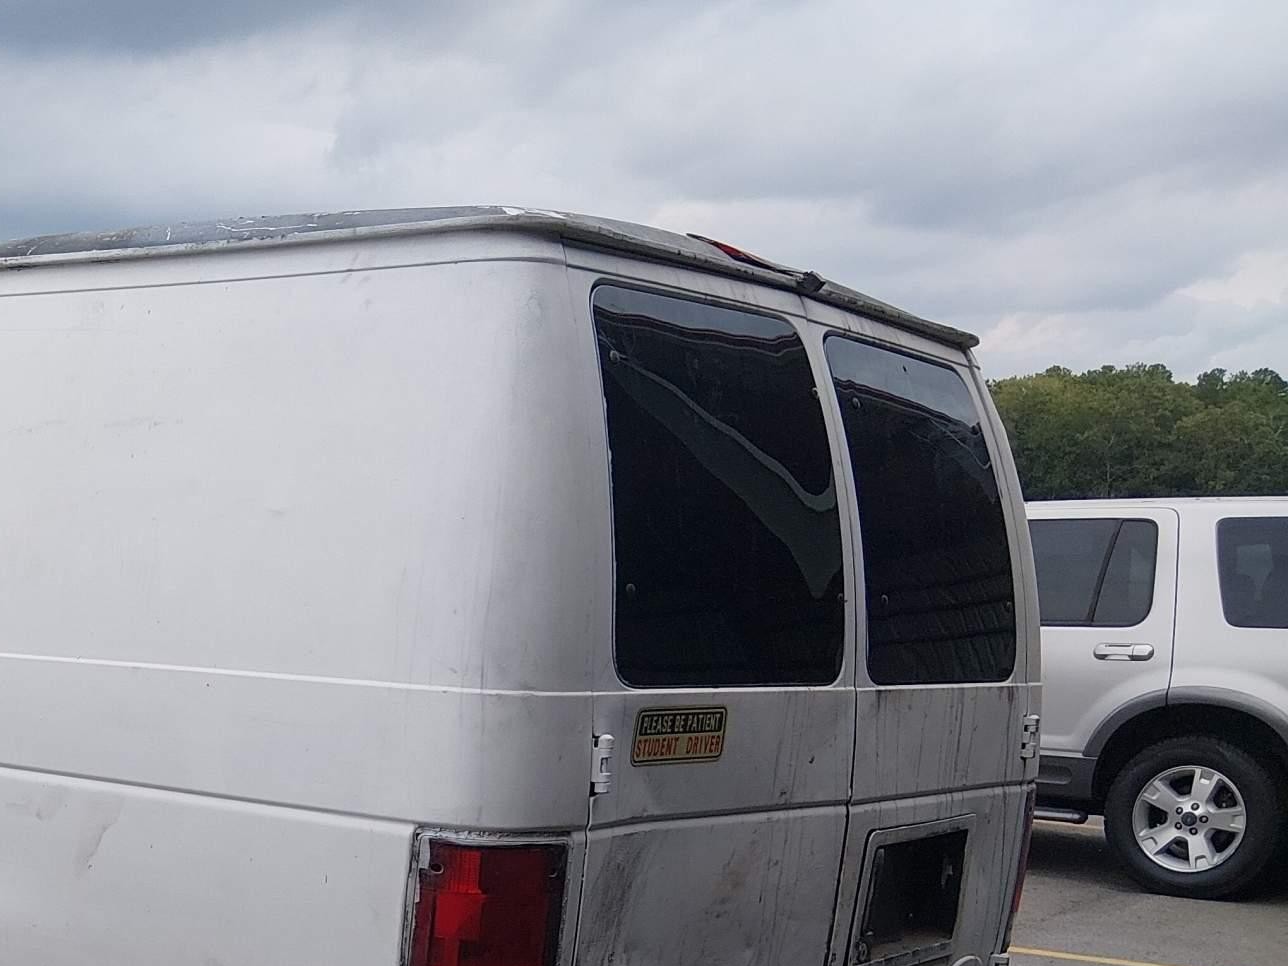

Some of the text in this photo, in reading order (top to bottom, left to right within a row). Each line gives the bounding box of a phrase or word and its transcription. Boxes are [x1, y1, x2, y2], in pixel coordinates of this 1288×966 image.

[641, 713, 722, 734] PLEASE BE PATIENT
[635, 734, 722, 758] STUDENT DRIVER
